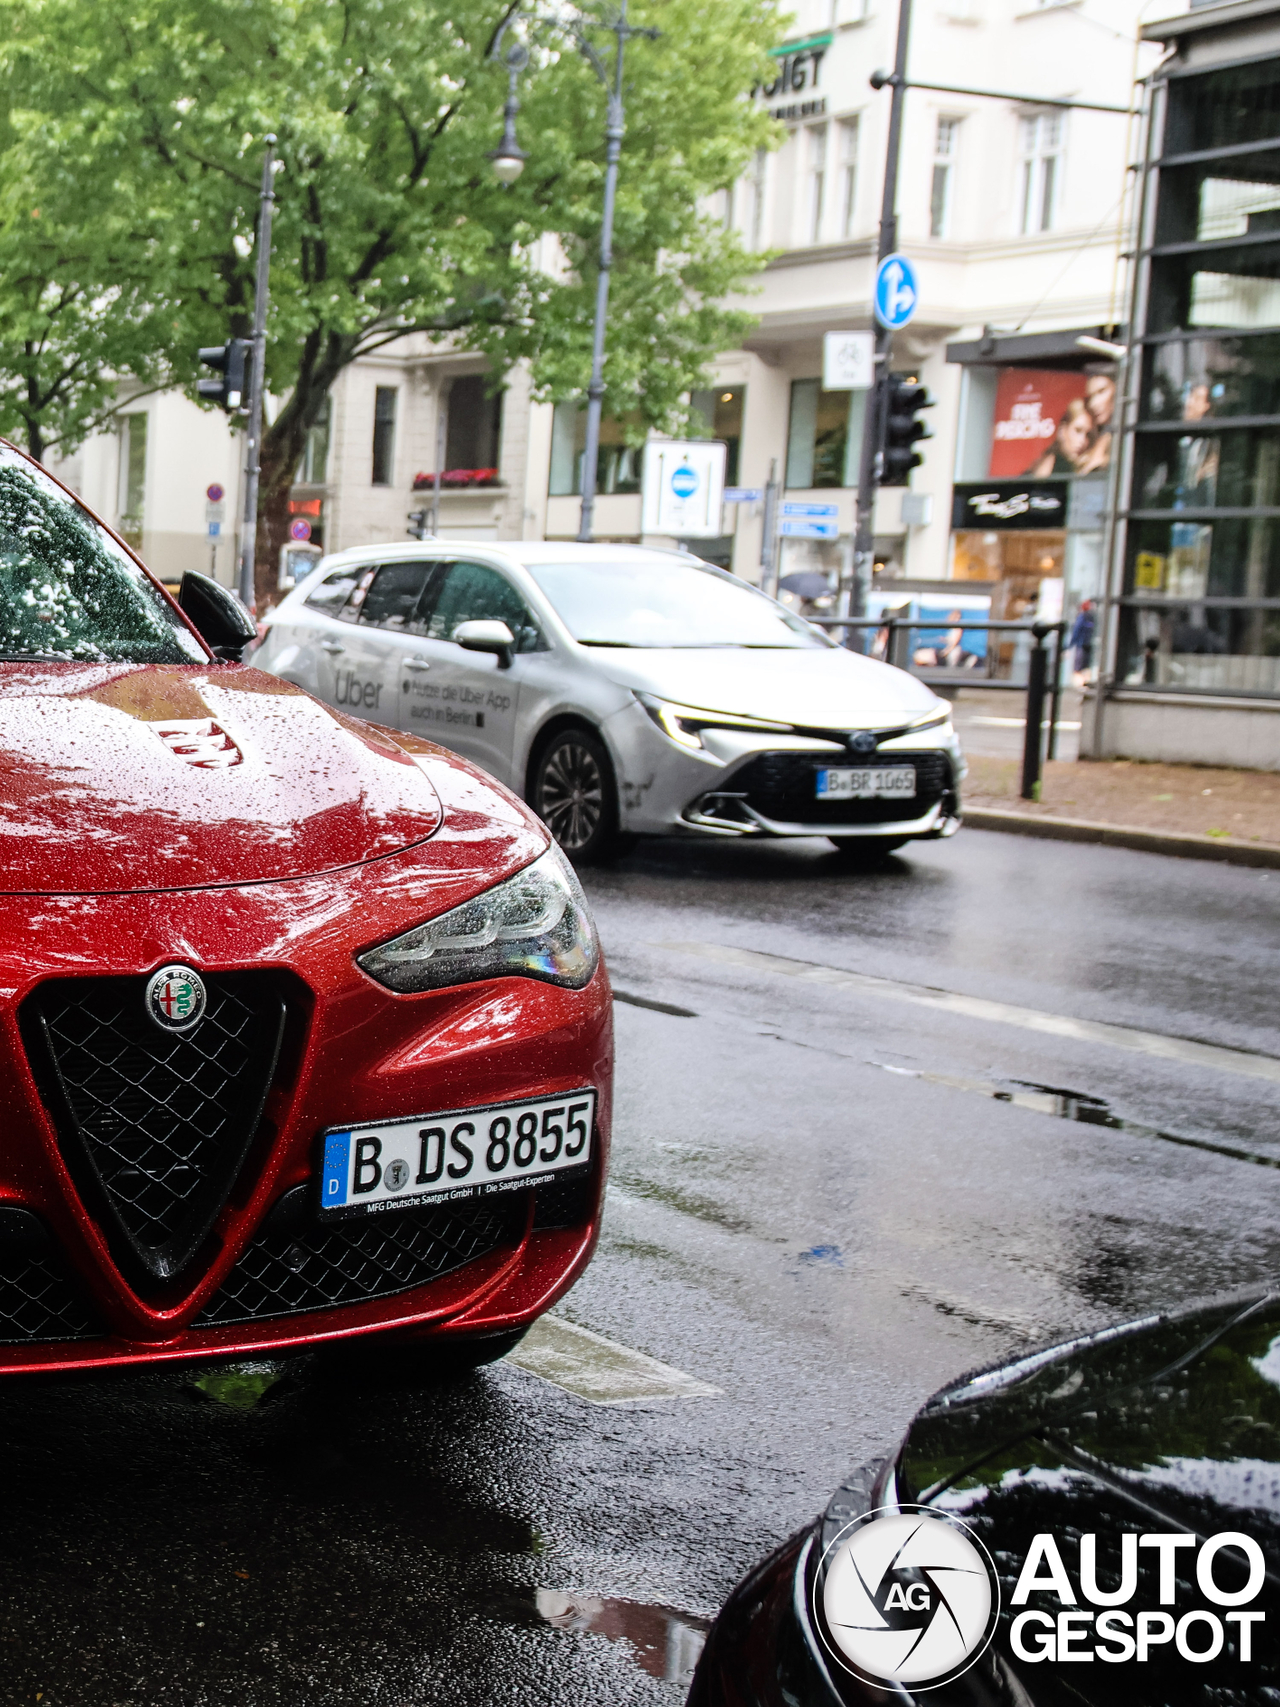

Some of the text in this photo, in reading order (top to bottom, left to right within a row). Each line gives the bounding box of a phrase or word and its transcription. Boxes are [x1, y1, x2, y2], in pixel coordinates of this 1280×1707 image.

[750, 51, 824, 98] IGT
[335, 669, 383, 709] Uber
[441, 684, 458, 700] die
[459, 686, 484, 704] Uber
[486, 690, 511, 712] App
[829, 771, 915, 791] B BR 1065
[153, 972, 202, 1000] ALFA ROMEO
[353, 1136, 383, 1195] B
[416, 1121, 476, 1185] DS
[486, 1102, 590, 1172] 8855
[329, 1179, 339, 1195] D
[367, 1174, 555, 1213] MFG Deutsche Saatgut GmbH Die Saatgut-Experten
